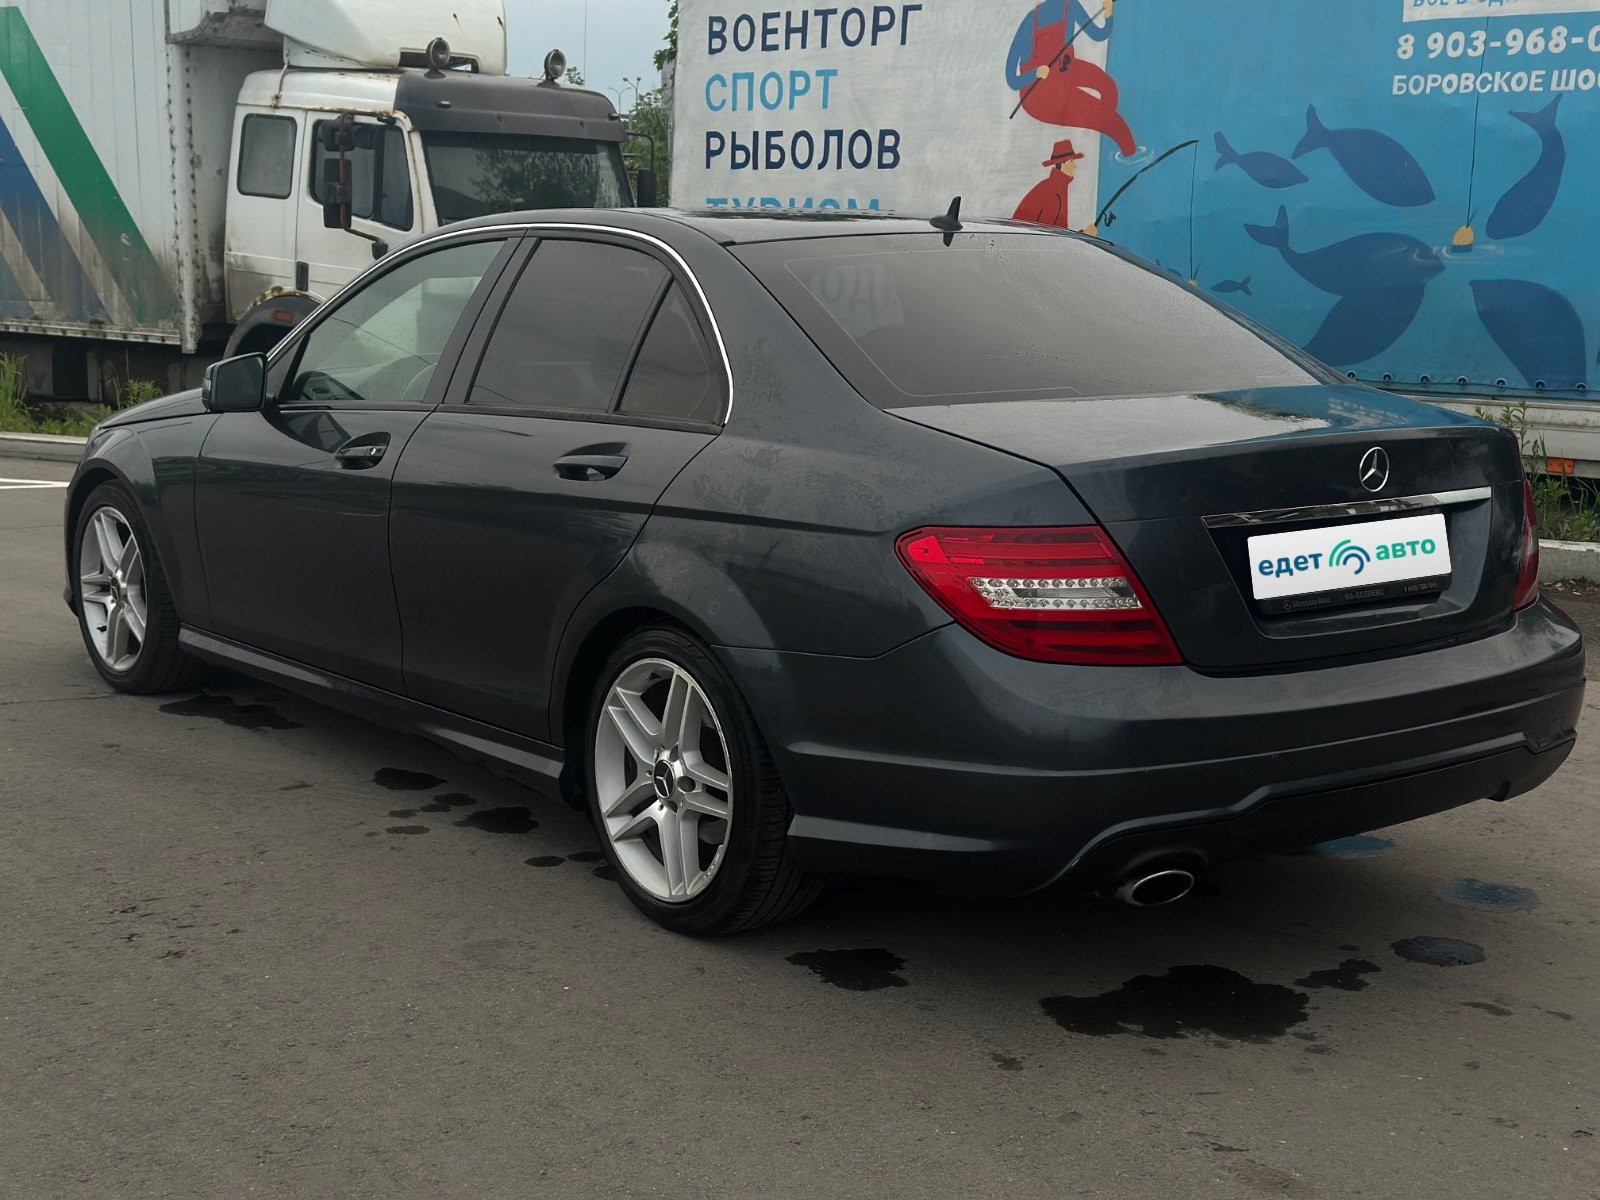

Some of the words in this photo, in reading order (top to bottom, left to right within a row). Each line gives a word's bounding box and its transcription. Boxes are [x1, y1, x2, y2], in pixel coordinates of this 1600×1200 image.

[707, 4, 923, 56] ВОЕНТОРГ
[1396, 33, 1415, 60] 8
[704, 68, 839, 113] СПОРТ
[1391, 69, 1547, 96] БОРОВСКОЕ
[1550, 68, 1600, 92] ШО
[705, 128, 901, 171] РЫБОЛОВ
